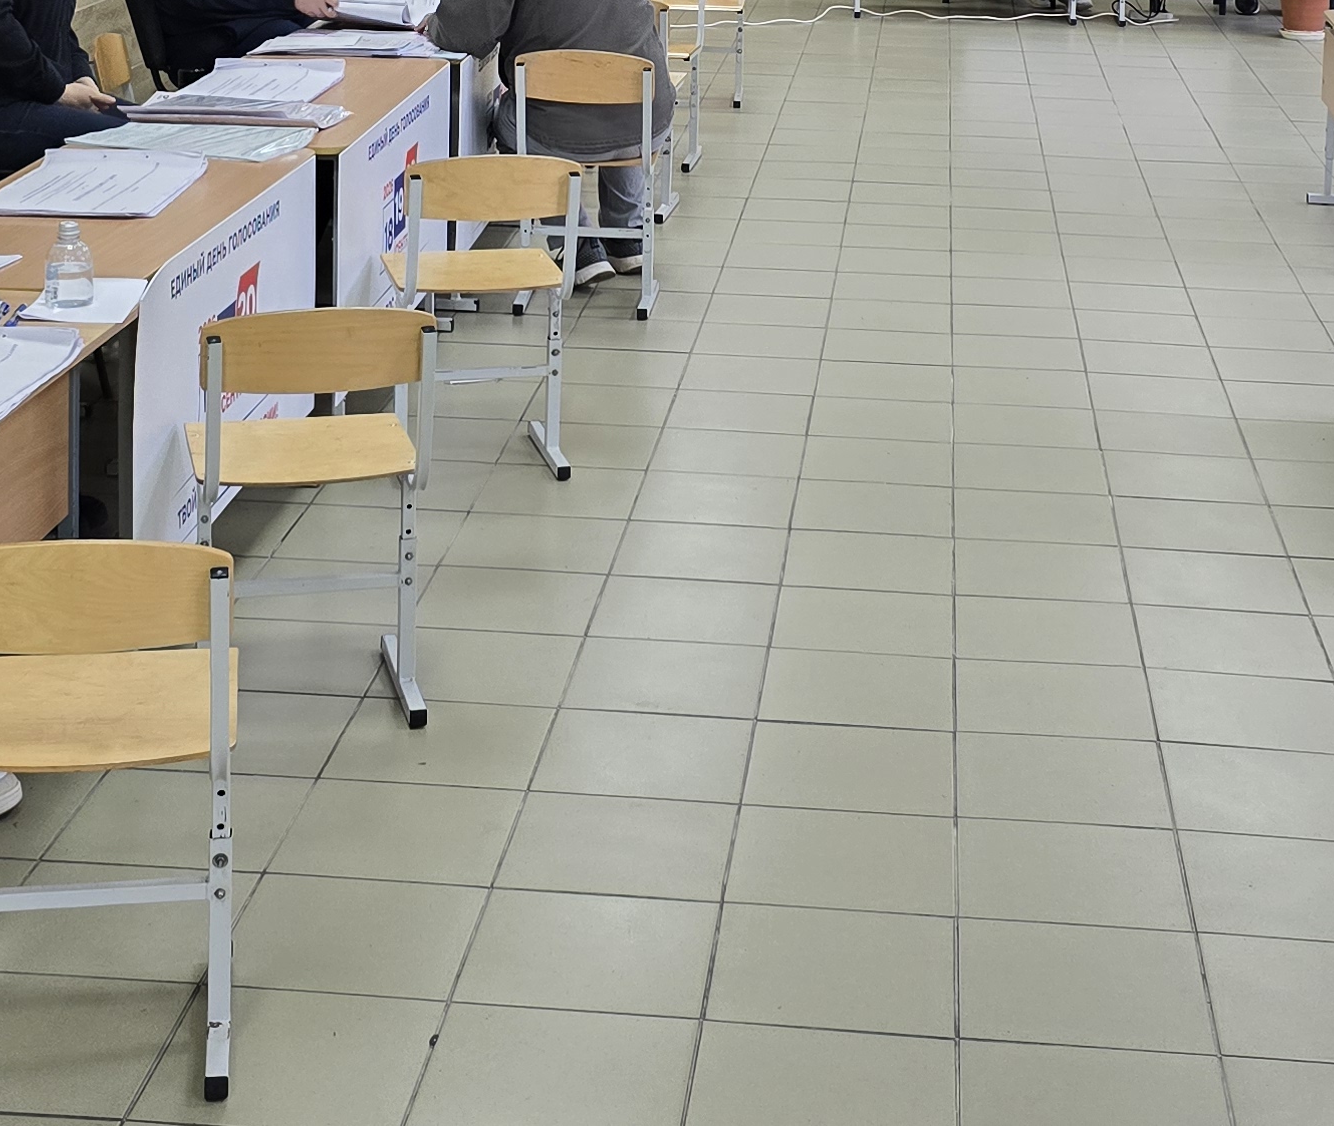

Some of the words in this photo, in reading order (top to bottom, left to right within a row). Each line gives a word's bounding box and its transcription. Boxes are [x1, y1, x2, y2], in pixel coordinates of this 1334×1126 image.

[394, 188, 404, 225] 19
[170, 250, 205, 300] ЕДИНЫЙ
[206, 242, 227, 275] ДЕНЬ
[228, 200, 281, 255] ГОЛОСОВАНИЯ
[384, 218, 394, 251] 18
